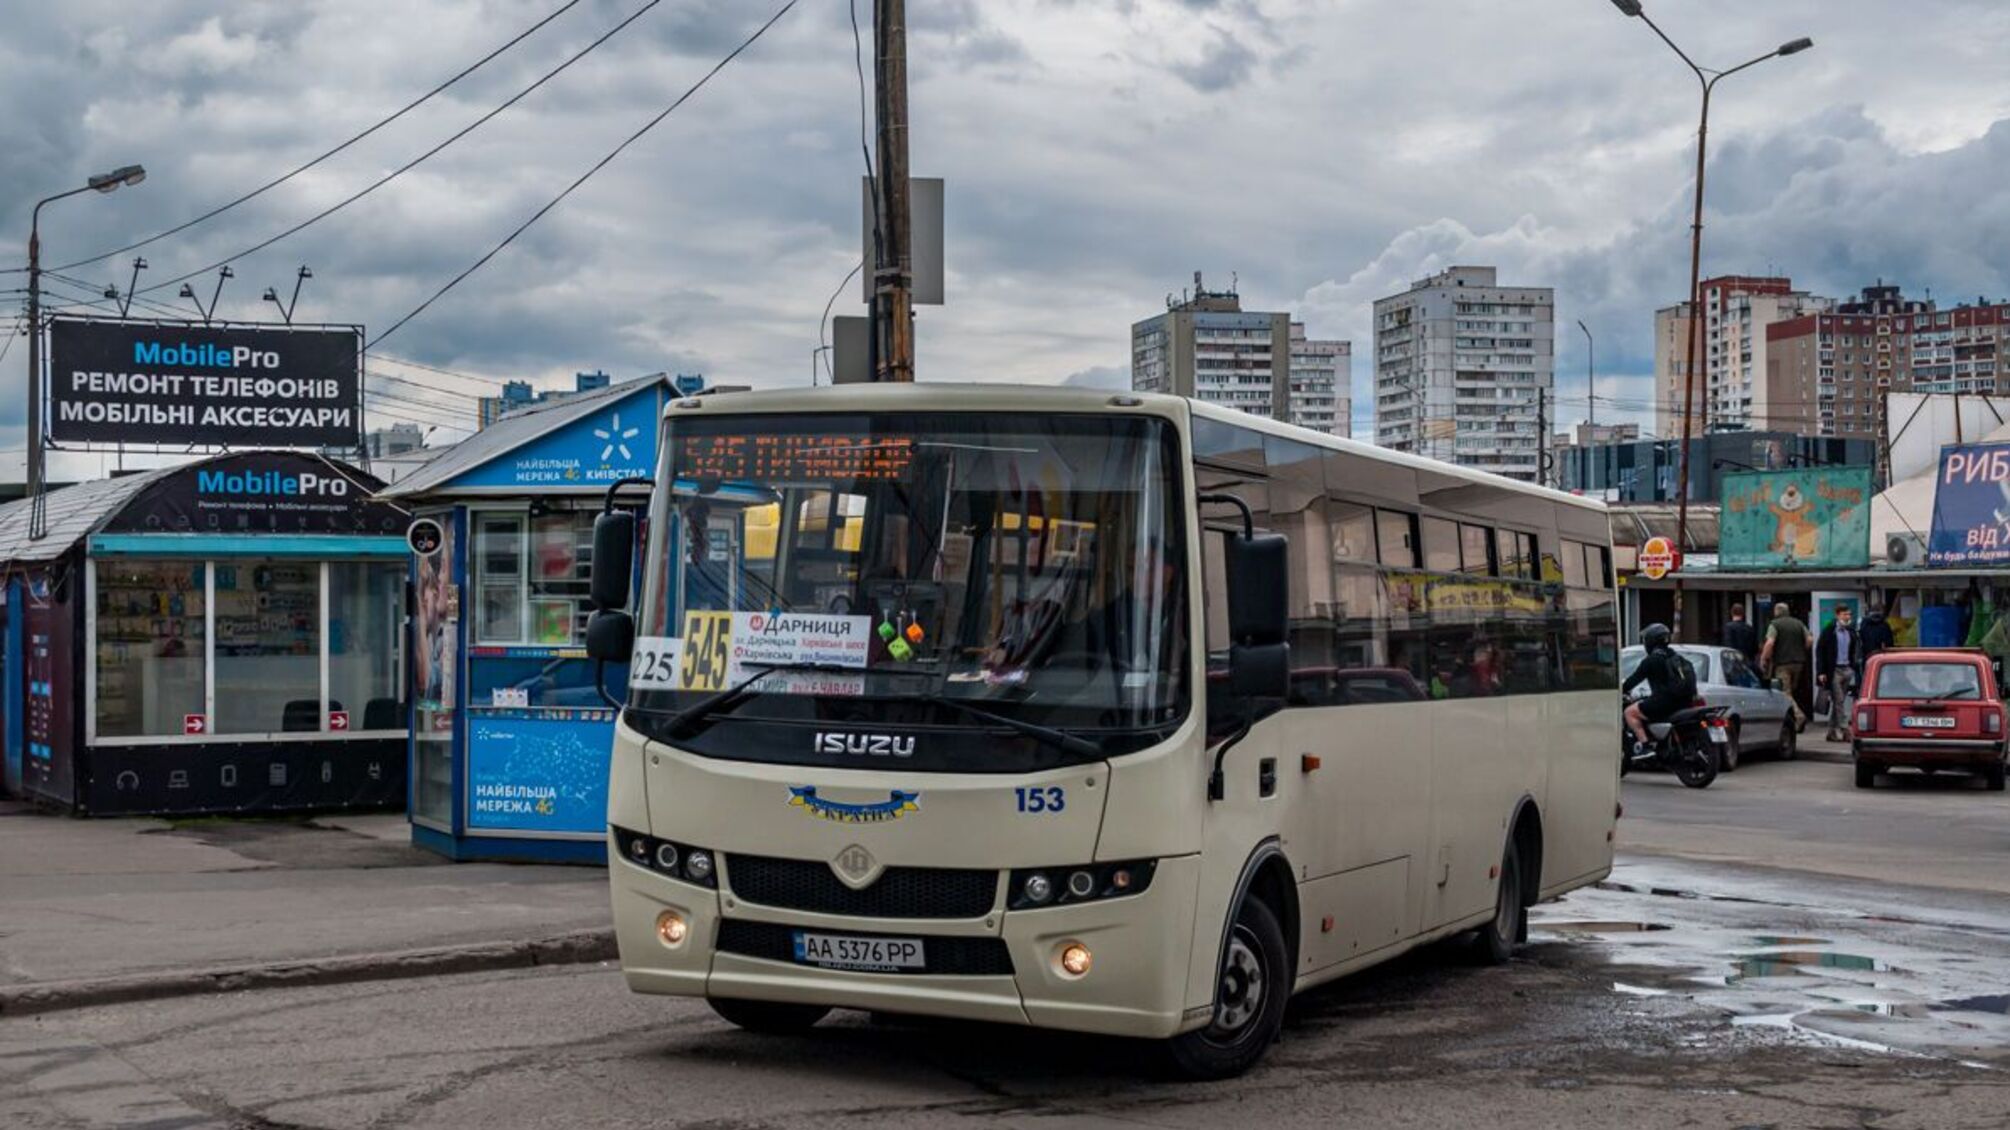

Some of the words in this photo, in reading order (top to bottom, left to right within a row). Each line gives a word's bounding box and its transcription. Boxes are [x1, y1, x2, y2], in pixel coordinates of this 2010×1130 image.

[134, 342, 280, 369] MobilePro
[71, 370, 185, 395] РЕМОНТ
[189, 375, 340, 400] ТЕЛЕФОНІВ
[60, 400, 194, 426] МОБІЛЬНІ
[201, 406, 350, 428] АКСЕСУАРИ
[516, 471, 560, 481] МЕРЕЖА
[517, 458, 580, 470] НАЙБІЛЬША
[585, 464, 646, 480] КИЇВСТАР
[198, 470, 348, 497] MobilePro
[1967, 523, 1998, 549] від
[764, 615, 851, 638] ДАРНИЦЯ
[682, 615, 730, 690] 545
[632, 651, 674, 682] 225
[814, 732, 916, 757] ISUZU
[476, 782, 557, 799] НАЙБІЛЬША
[1015, 787, 1065, 813] 153
[476, 800, 533, 814] МЕРЕЖА
[807, 937, 834, 959] AA
[838, 939, 884, 962] 5376
[886, 942, 917, 963] PP
